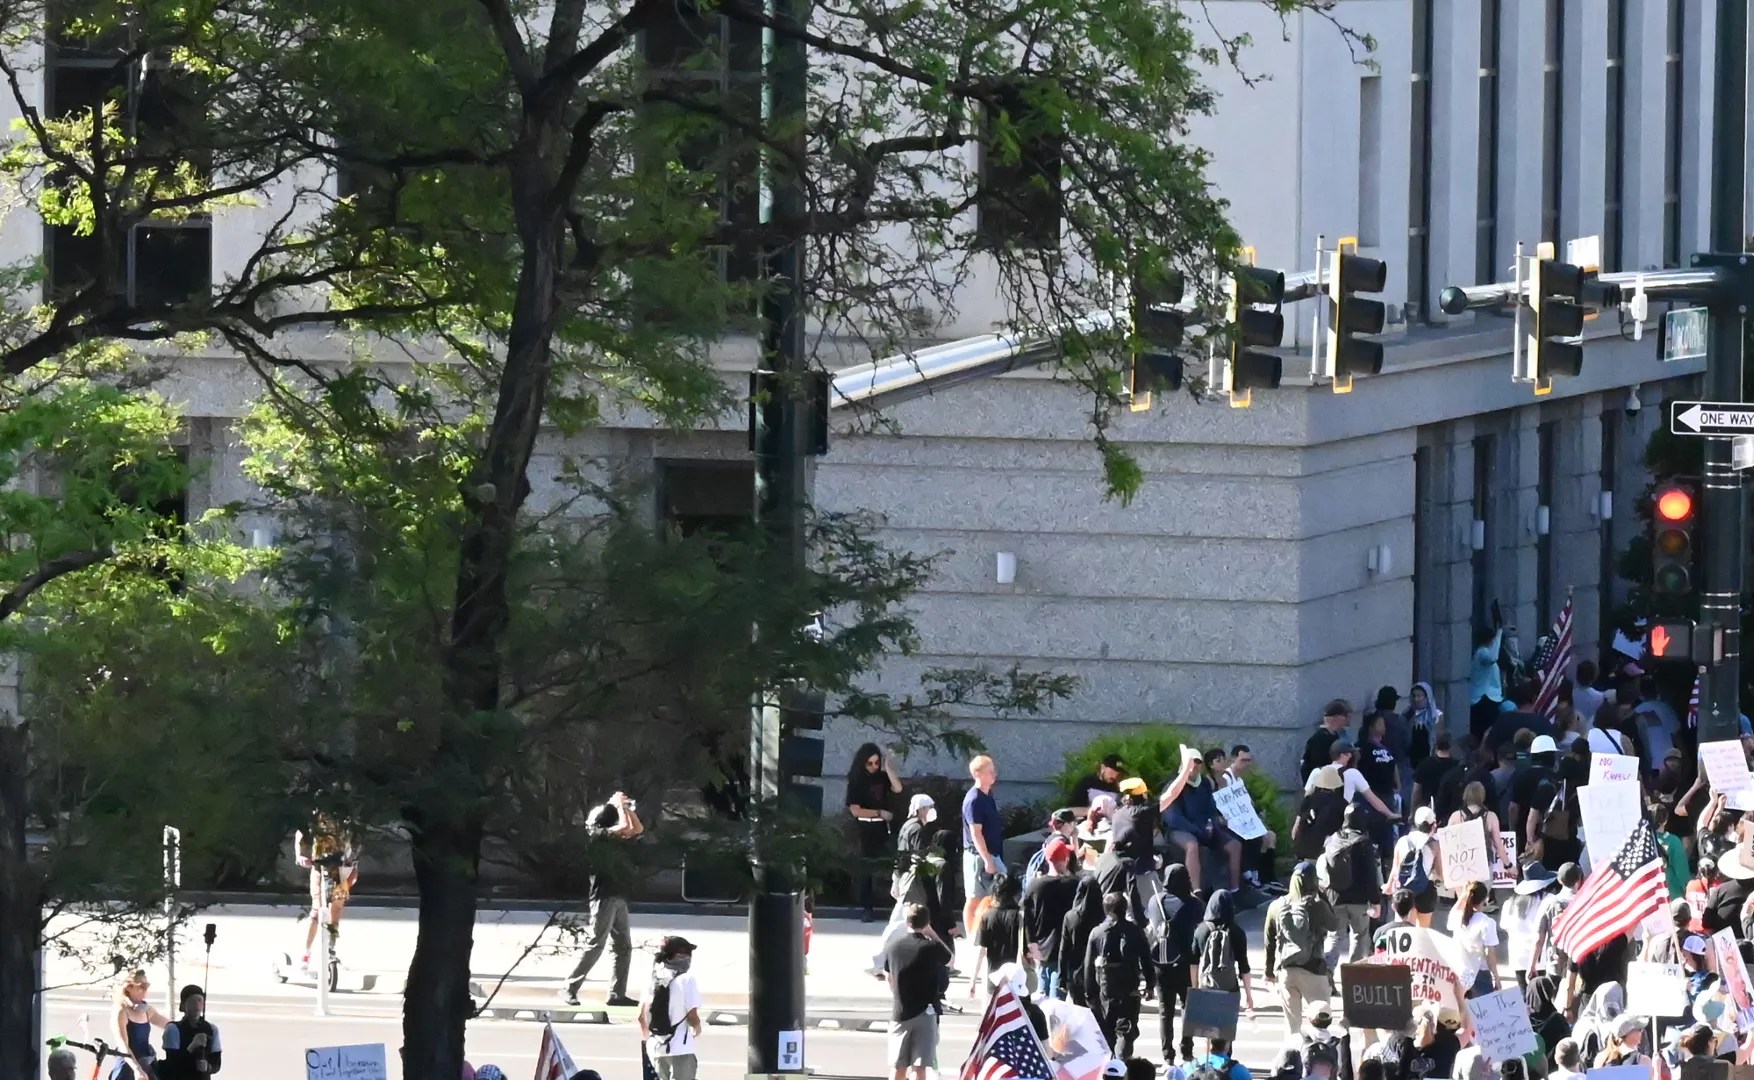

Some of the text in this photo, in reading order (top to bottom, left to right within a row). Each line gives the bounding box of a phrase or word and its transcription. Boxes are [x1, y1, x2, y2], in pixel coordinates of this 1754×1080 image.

[1700, 412, 1754, 426] ONE WAY
[1449, 848, 1476, 866] NOT
[1387, 930, 1412, 954] NO
[1353, 986, 1404, 1007] BUILT
